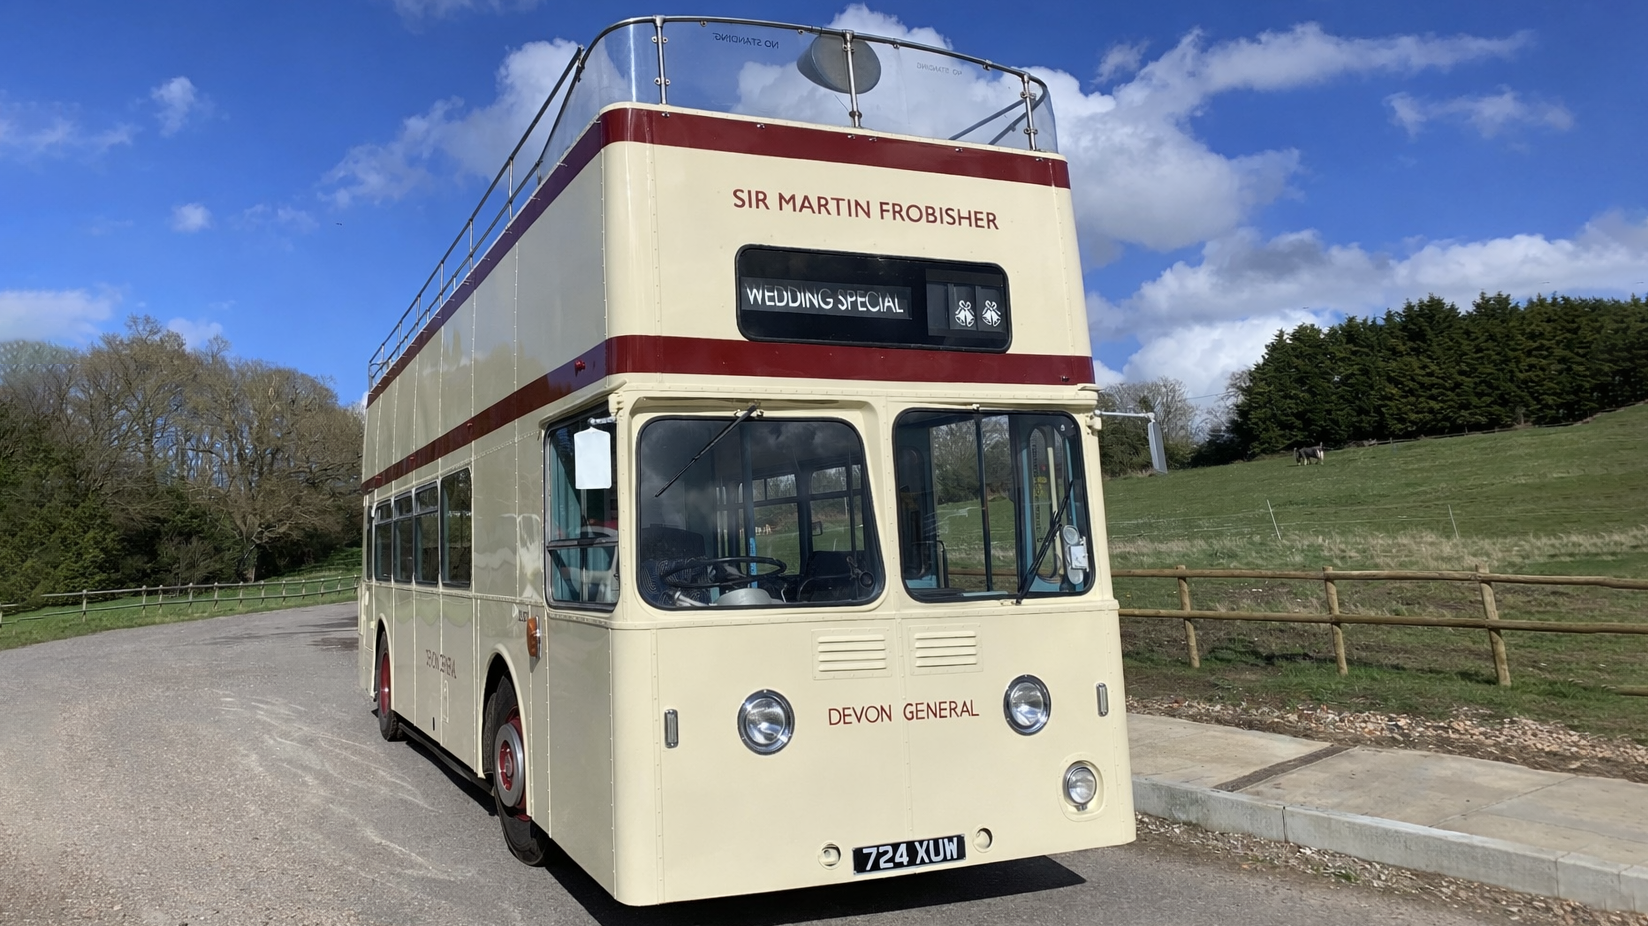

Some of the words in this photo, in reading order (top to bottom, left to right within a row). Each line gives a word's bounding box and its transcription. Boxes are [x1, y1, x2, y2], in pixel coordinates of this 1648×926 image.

[732, 188, 770, 210] SIR
[778, 192, 871, 219] MARTIN
[879, 201, 999, 230] FROBISHER
[745, 284, 833, 310] WEDDING
[837, 289, 903, 313] SPECIAL
[828, 704, 892, 726] DEVON
[903, 699, 980, 721] GENERAL
[862, 843, 909, 871] 724
[914, 837, 958, 864] XUW
